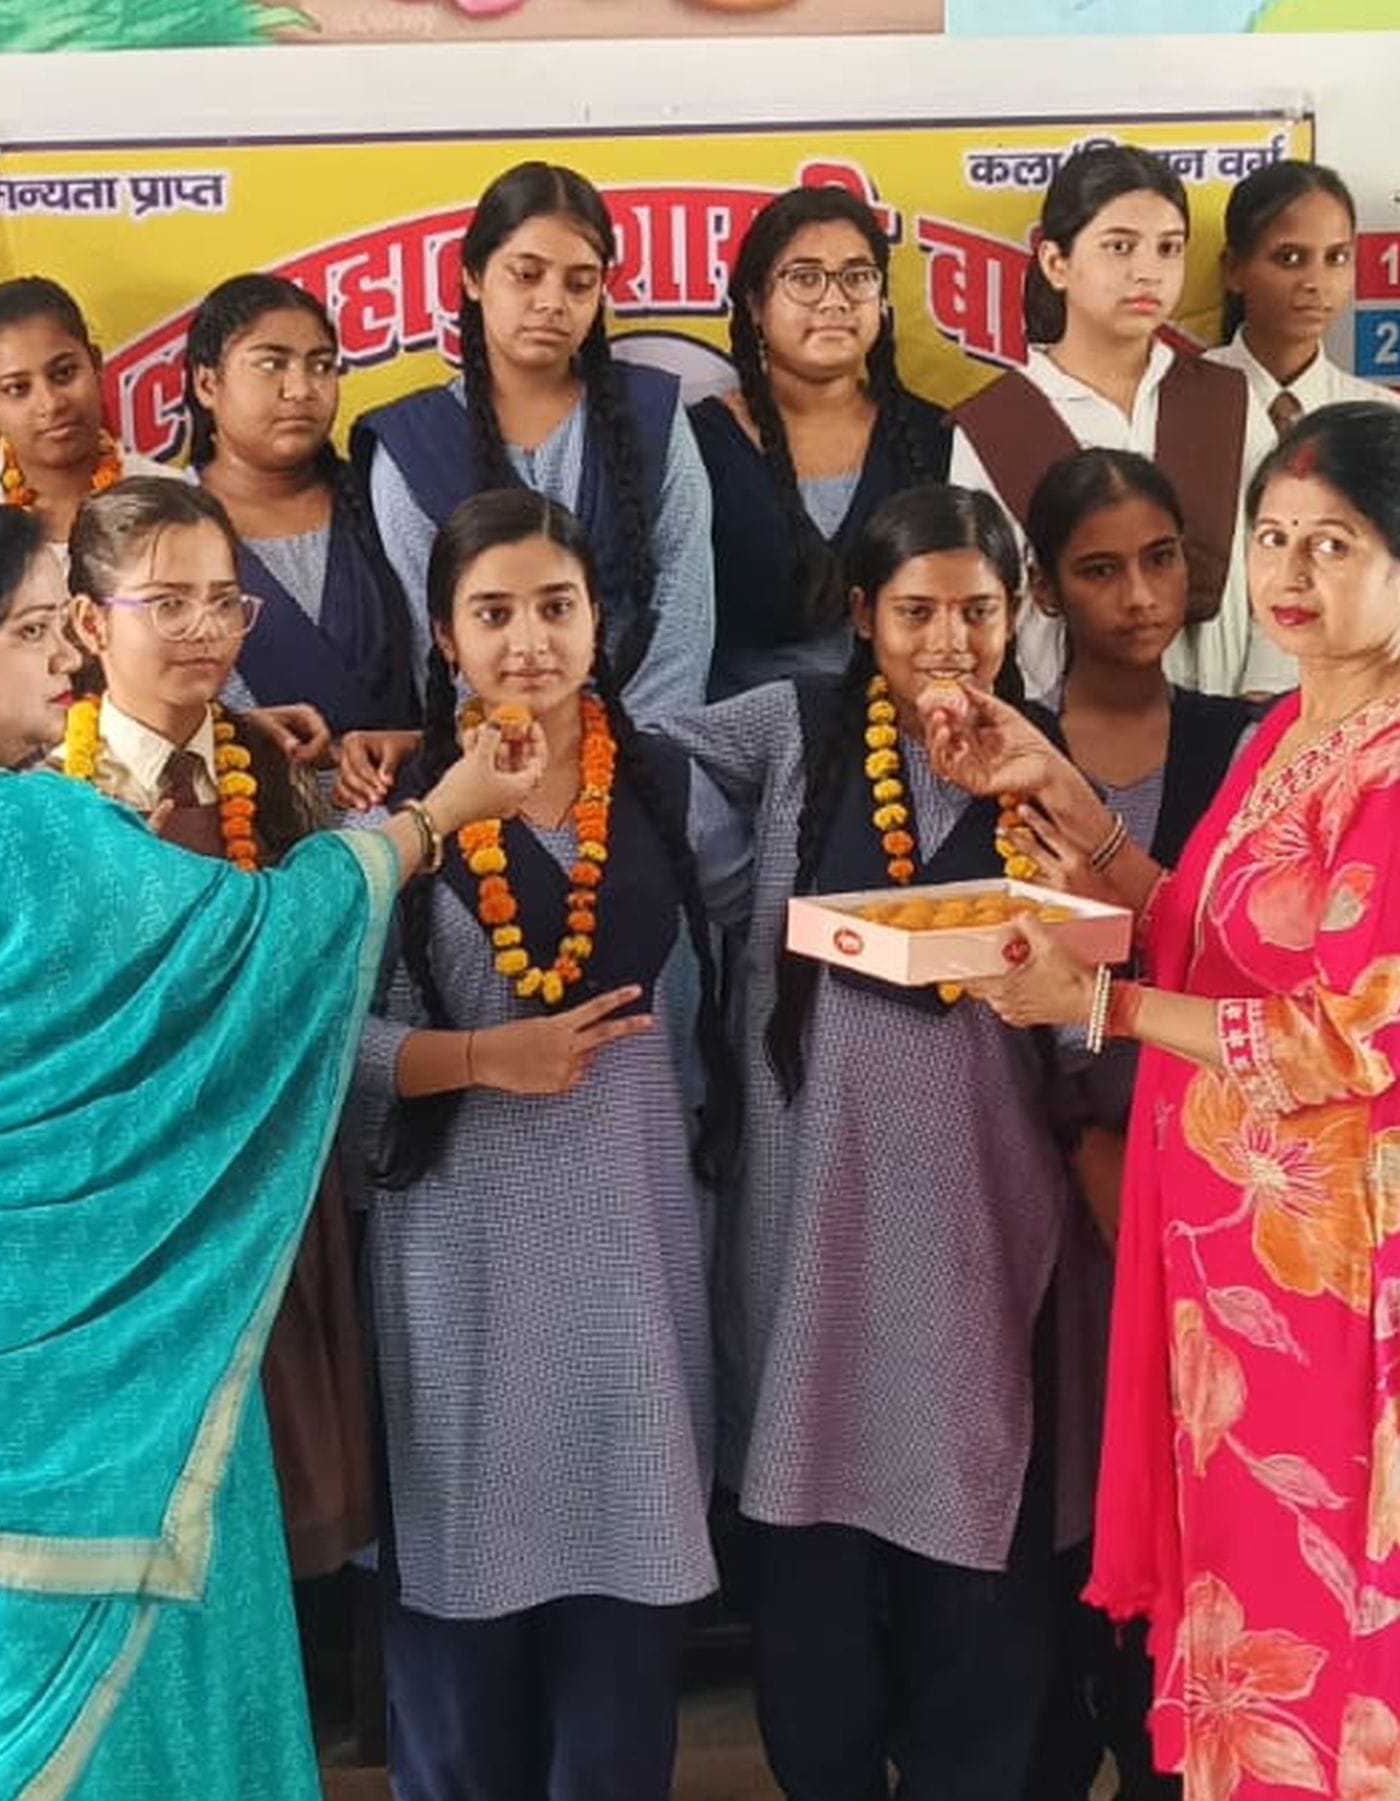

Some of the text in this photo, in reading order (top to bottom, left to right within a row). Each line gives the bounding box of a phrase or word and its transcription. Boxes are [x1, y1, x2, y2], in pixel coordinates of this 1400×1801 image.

[129, 175, 223, 214] प्राप्त
[1380, 242, 1399, 286] 1
[1375, 321, 1400, 365] 2
